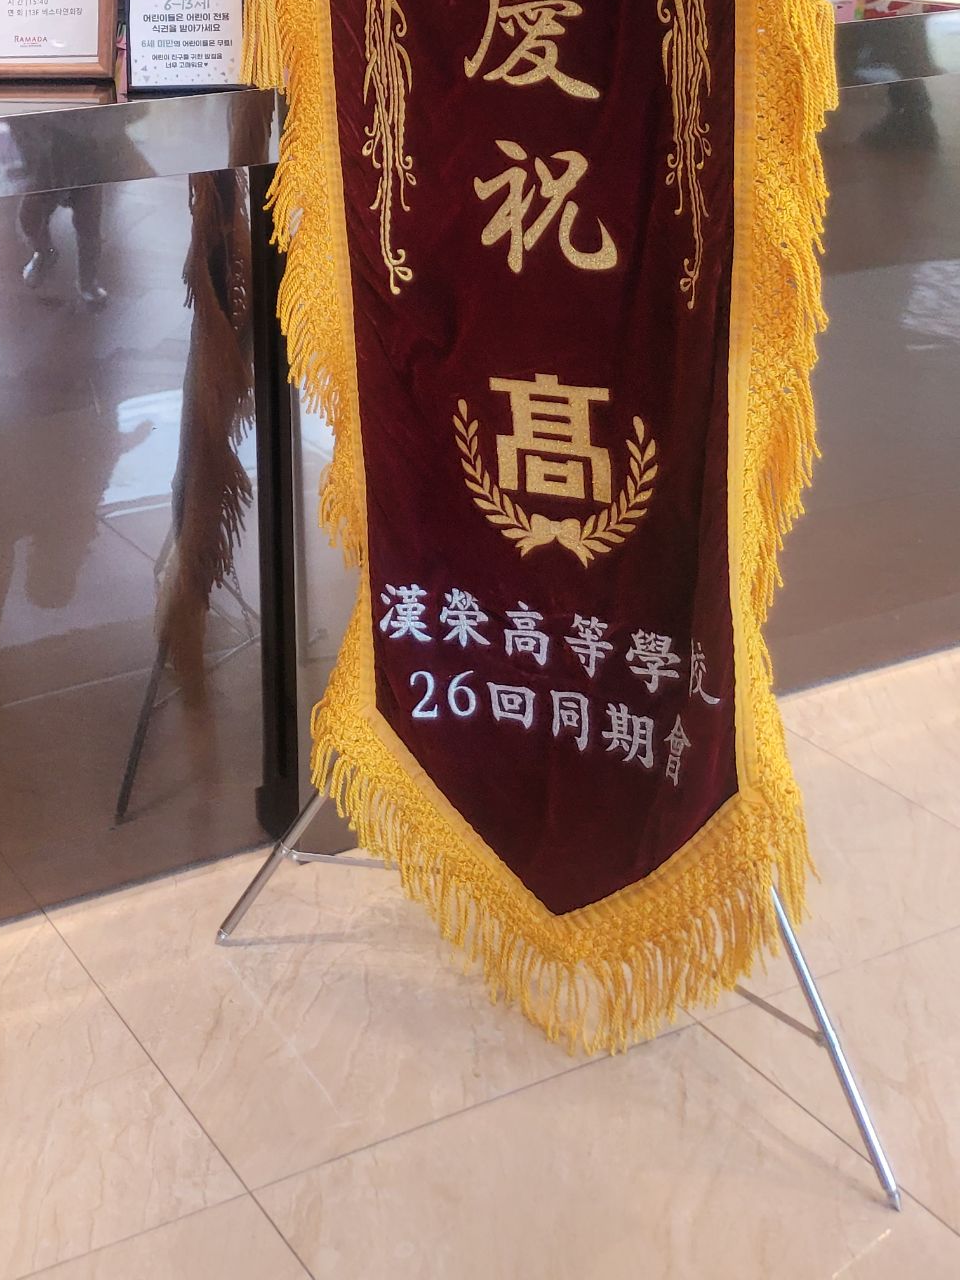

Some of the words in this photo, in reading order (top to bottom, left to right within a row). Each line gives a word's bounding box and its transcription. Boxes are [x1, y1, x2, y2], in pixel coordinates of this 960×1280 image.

[143, 13, 184, 23] 어린이들은
[186, 13, 211, 22] 어린이
[152, 24, 177, 33] 식권을
[179, 23, 221, 33] 받아가세요
[14, 35, 48, 43] RAMADA
[182, 39, 215, 47] 어린이들은
[378, 583, 721, 705] 漢榮高等學校
